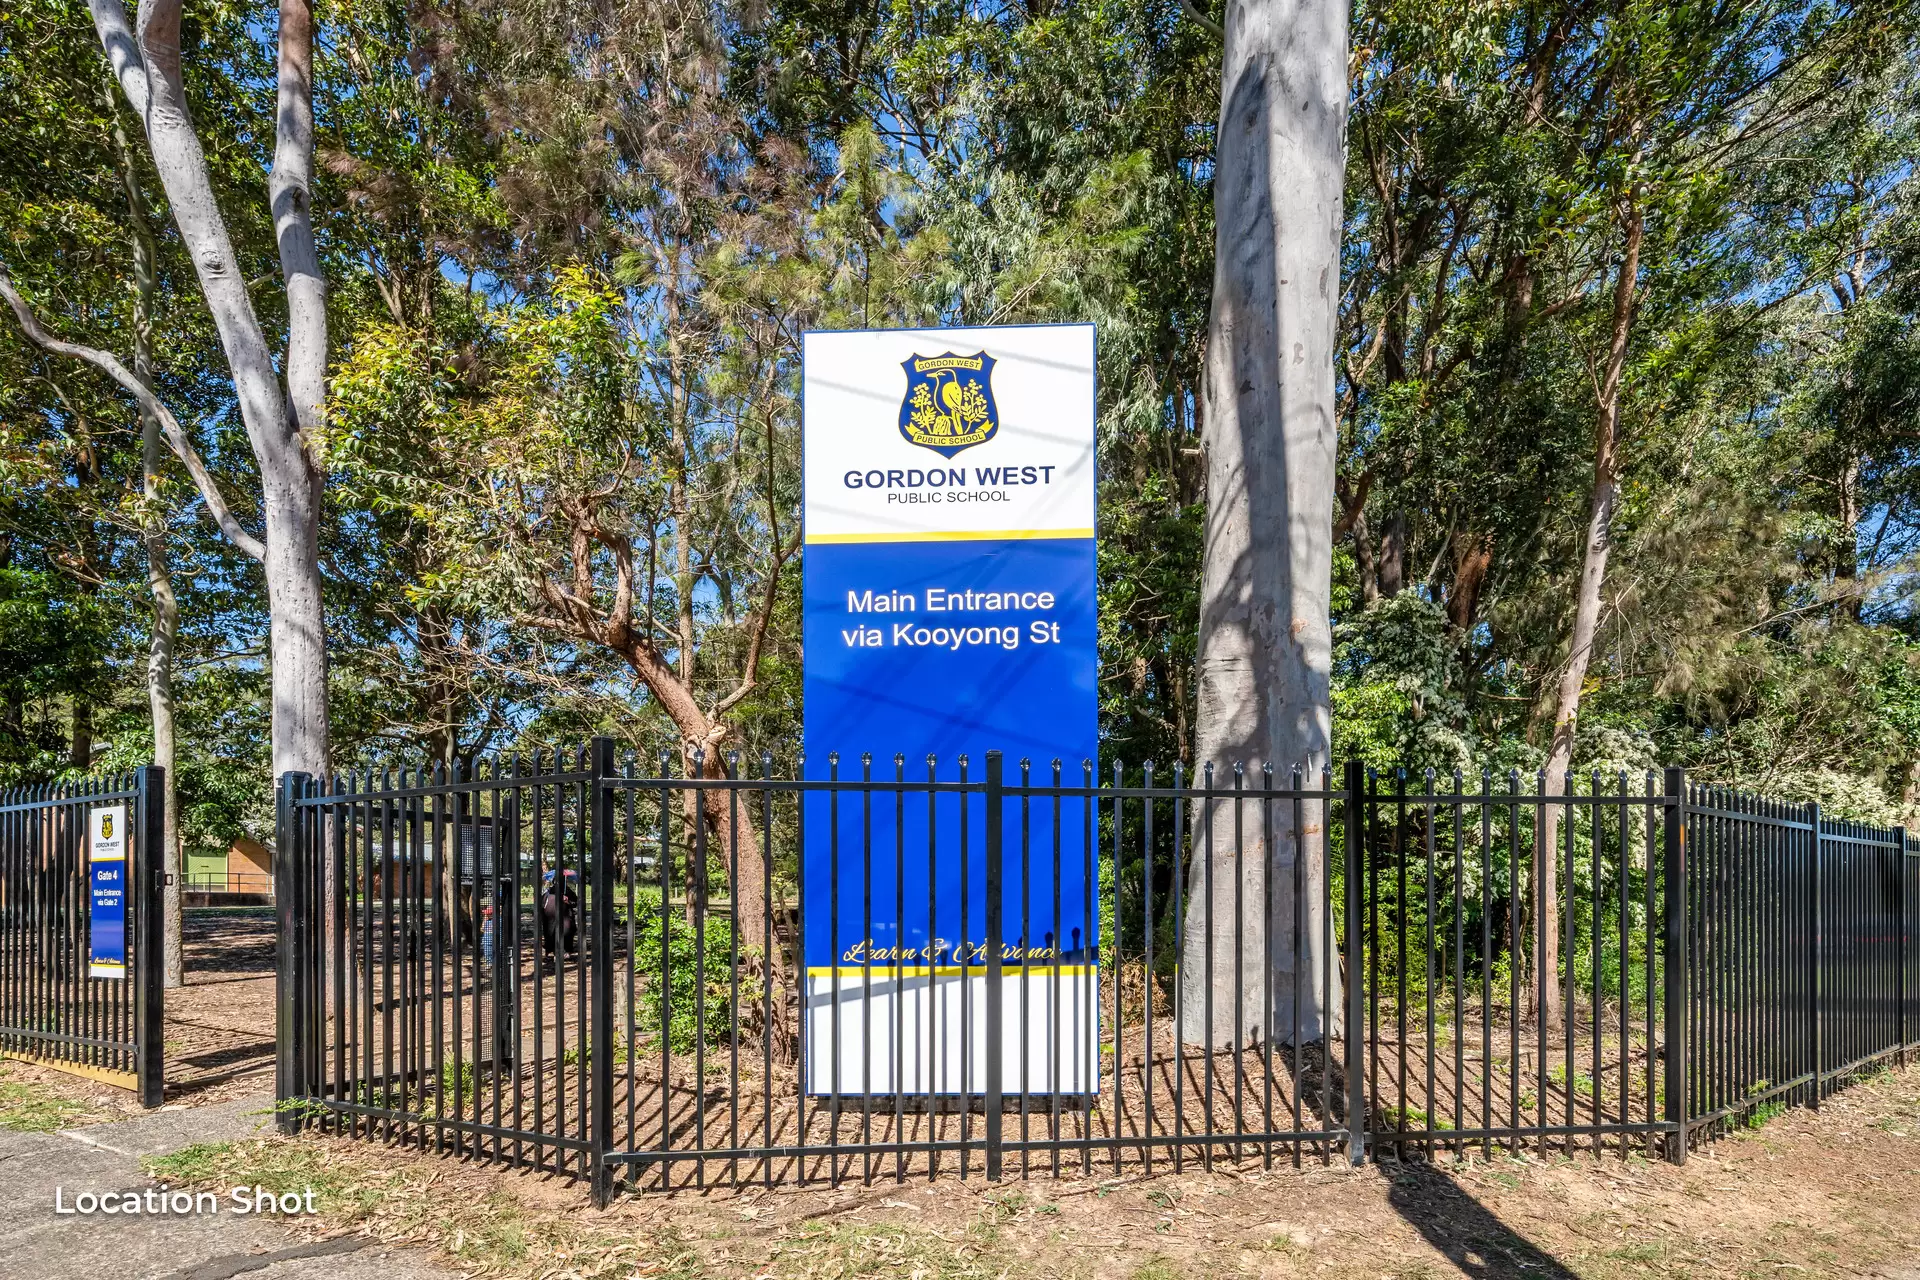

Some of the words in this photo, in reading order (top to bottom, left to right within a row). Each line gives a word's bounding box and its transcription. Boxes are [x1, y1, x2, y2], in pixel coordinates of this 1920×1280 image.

[918, 359, 954, 370] GORDON
[956, 359, 980, 369] WEST
[916, 434, 946, 445] PUBLIC
[949, 433, 984, 445] SCHOOL
[843, 468, 966, 489] GORDON
[975, 465, 1056, 486] WEST
[887, 492, 942, 504] PUBLIC
[946, 491, 1011, 503] SCHOOL
[848, 589, 916, 613] Main
[926, 588, 1055, 611] Entrance
[842, 624, 883, 647] via
[893, 623, 1019, 651] Kooyong
[1029, 620, 1061, 644] St
[97, 870, 112, 880] Gate
[113, 869, 118, 880] 4
[952, 941, 1062, 963] Avanc
